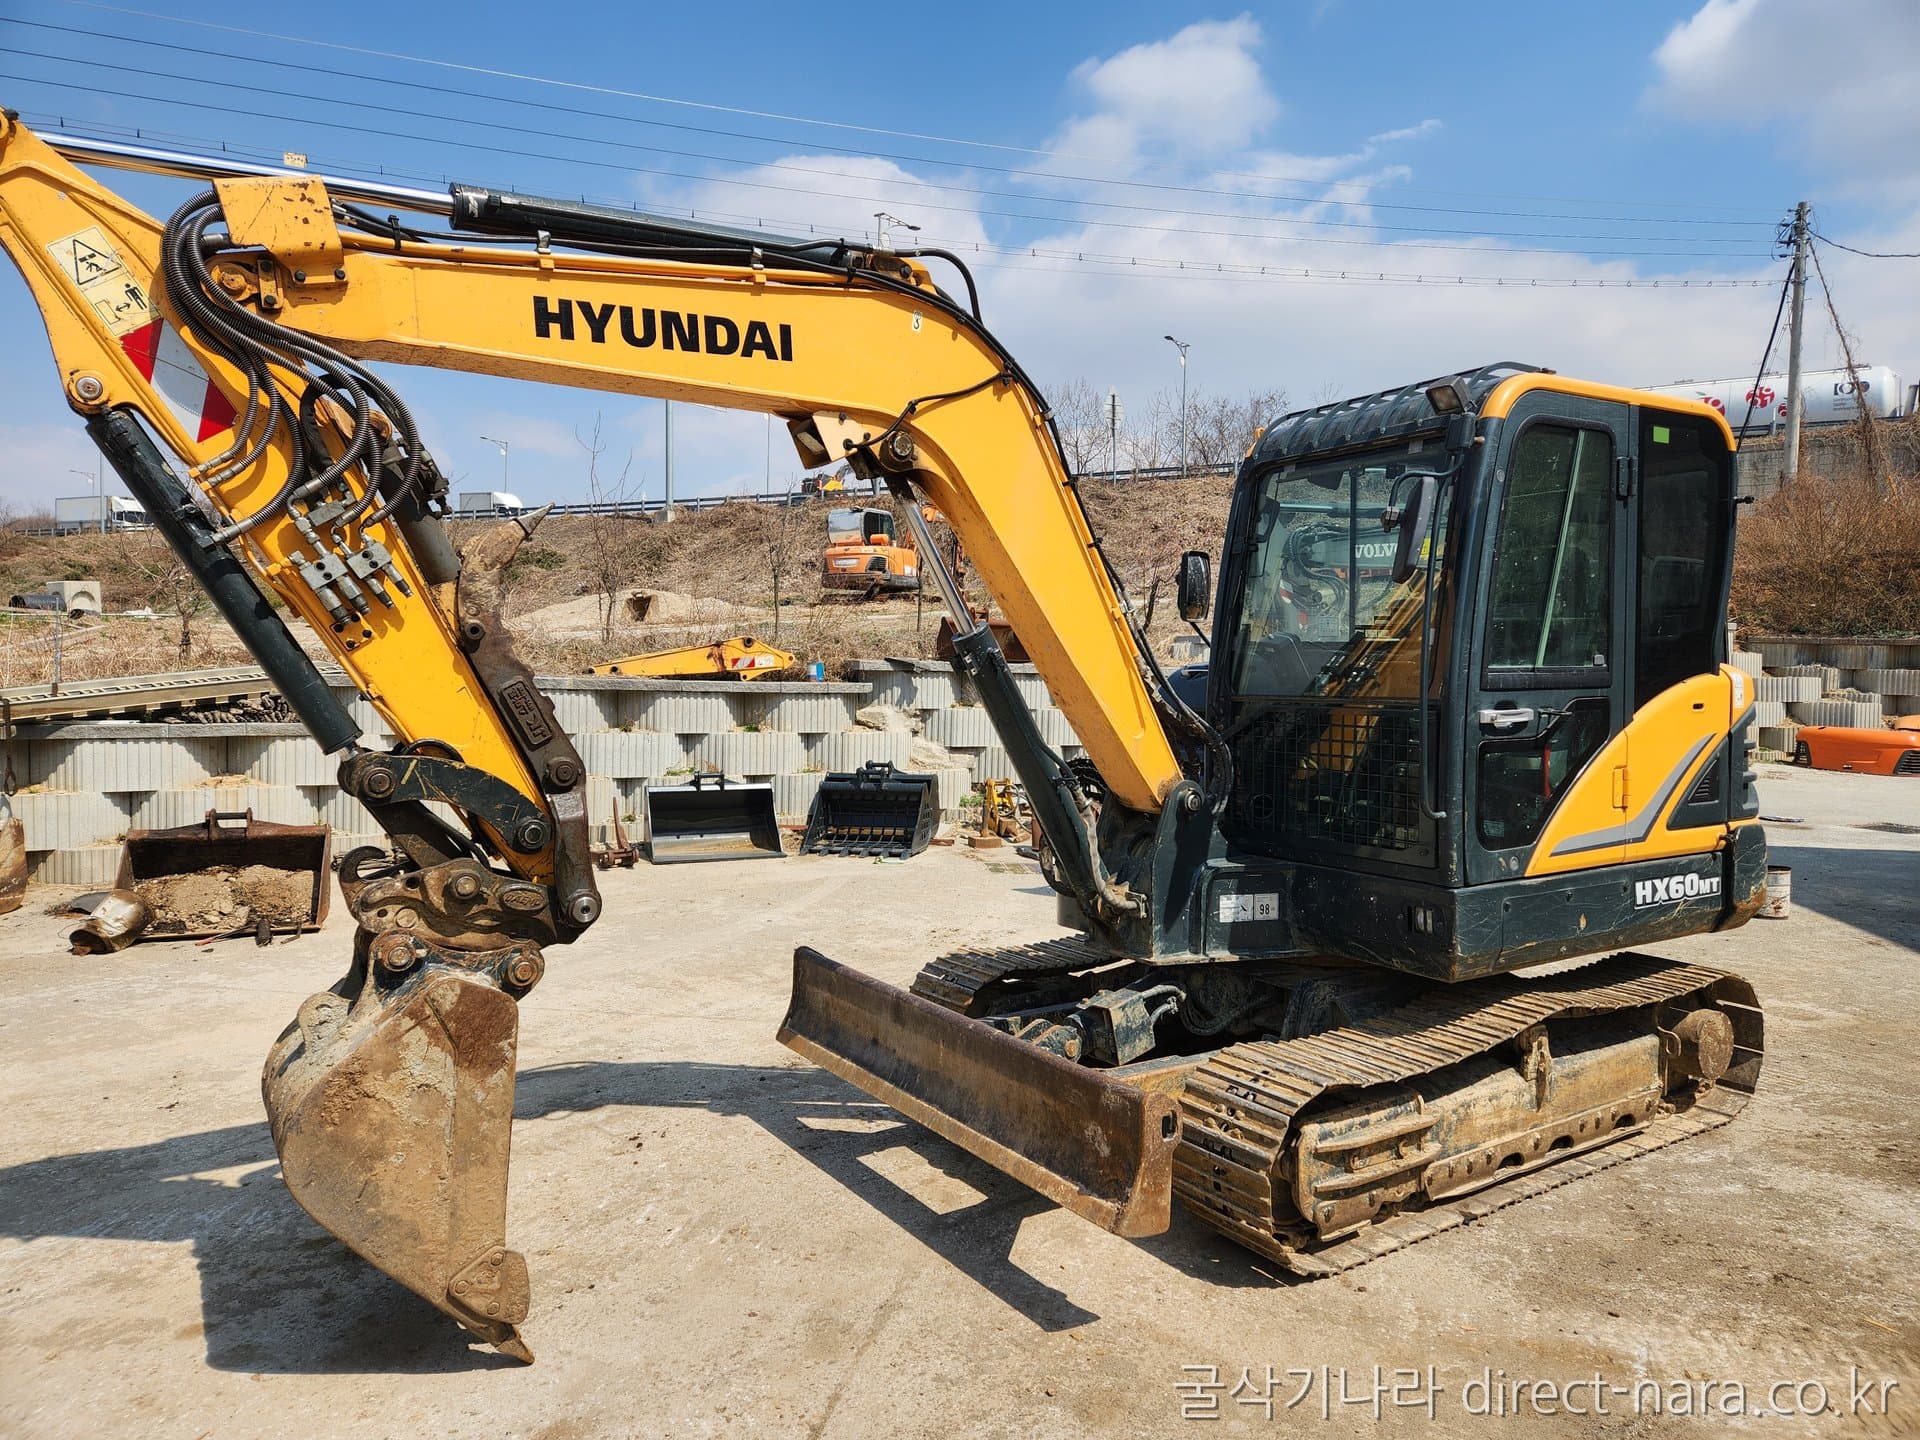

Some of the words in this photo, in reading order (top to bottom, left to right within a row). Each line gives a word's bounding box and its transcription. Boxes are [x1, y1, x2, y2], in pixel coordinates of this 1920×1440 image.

[533, 295, 793, 362] HYUNDAI
[1355, 542, 1398, 558] VOLV
[1634, 872, 1721, 905] HX60MT
[1259, 903, 1270, 915] 98
